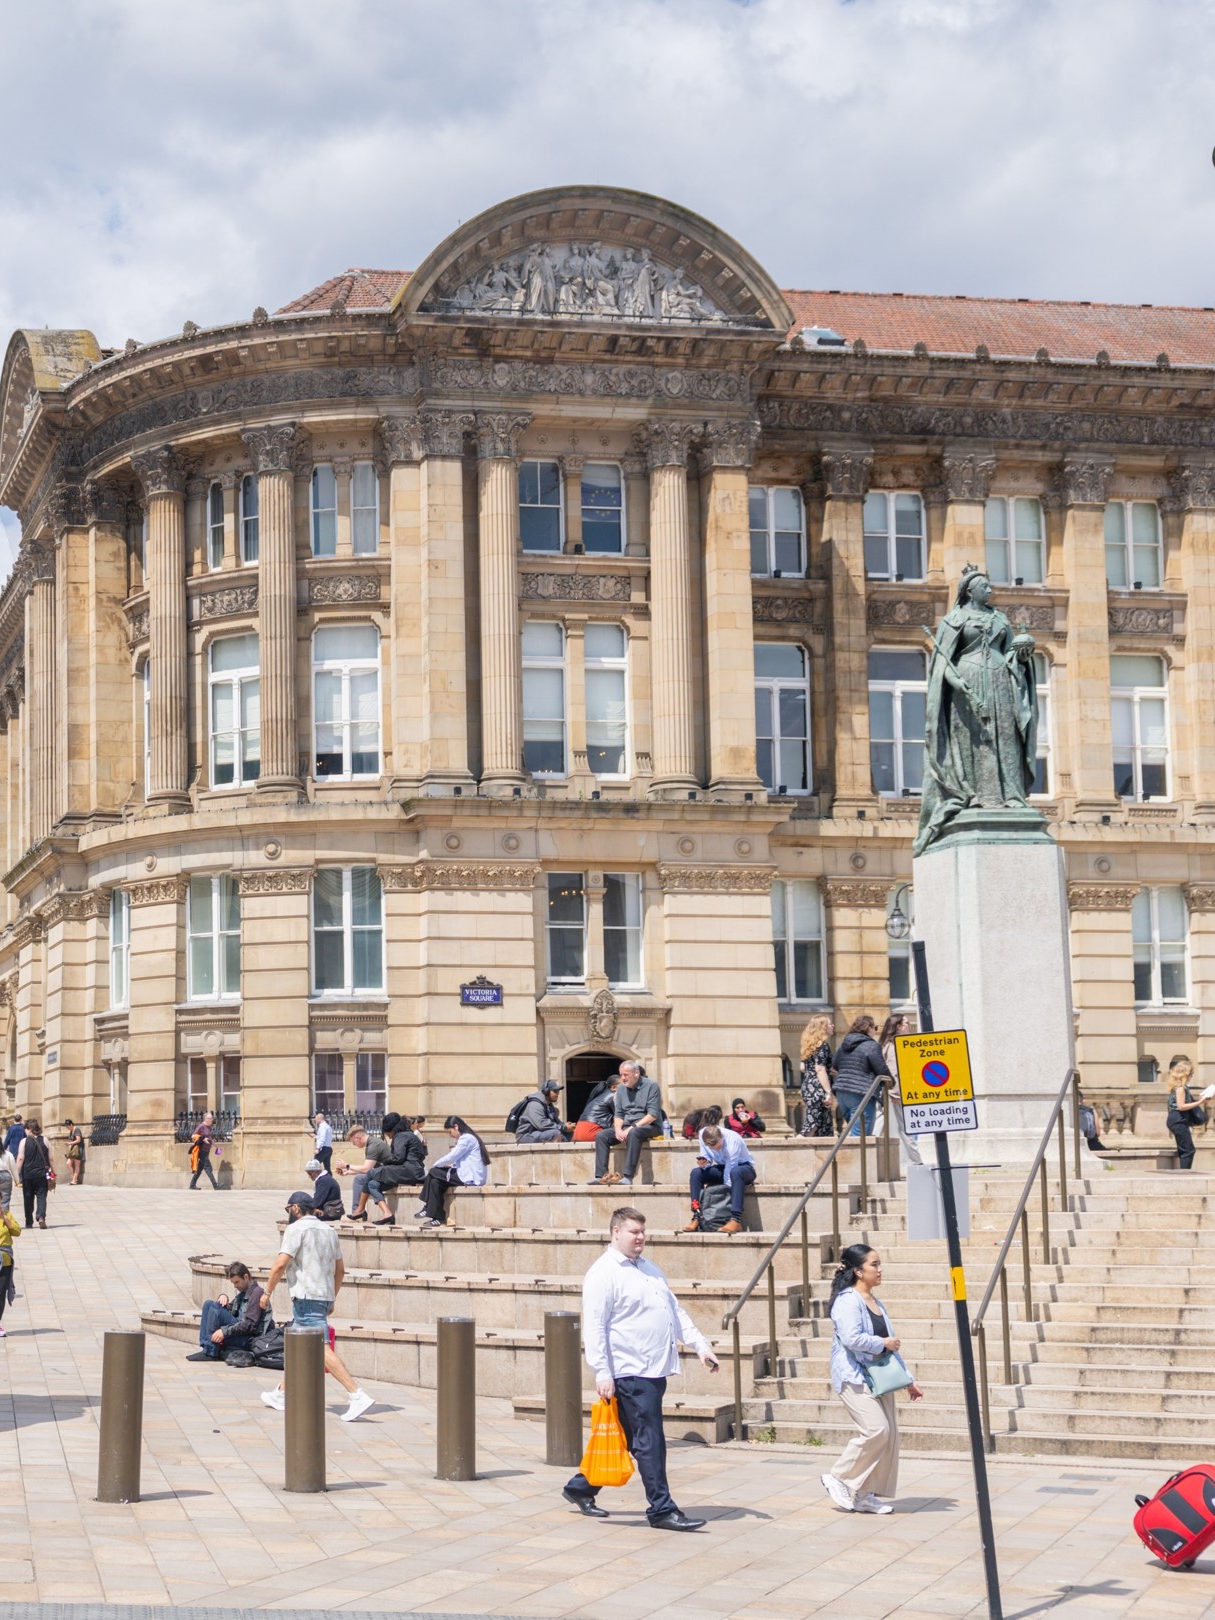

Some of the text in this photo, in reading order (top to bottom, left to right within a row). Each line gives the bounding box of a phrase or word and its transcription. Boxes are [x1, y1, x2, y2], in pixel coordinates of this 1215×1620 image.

[902, 1037, 960, 1048] Pedestrian
[919, 1049, 945, 1058] Zone
[906, 1088, 968, 1100] At any time
[910, 1106, 968, 1118] No loading
[910, 1117, 971, 1129] at any time
